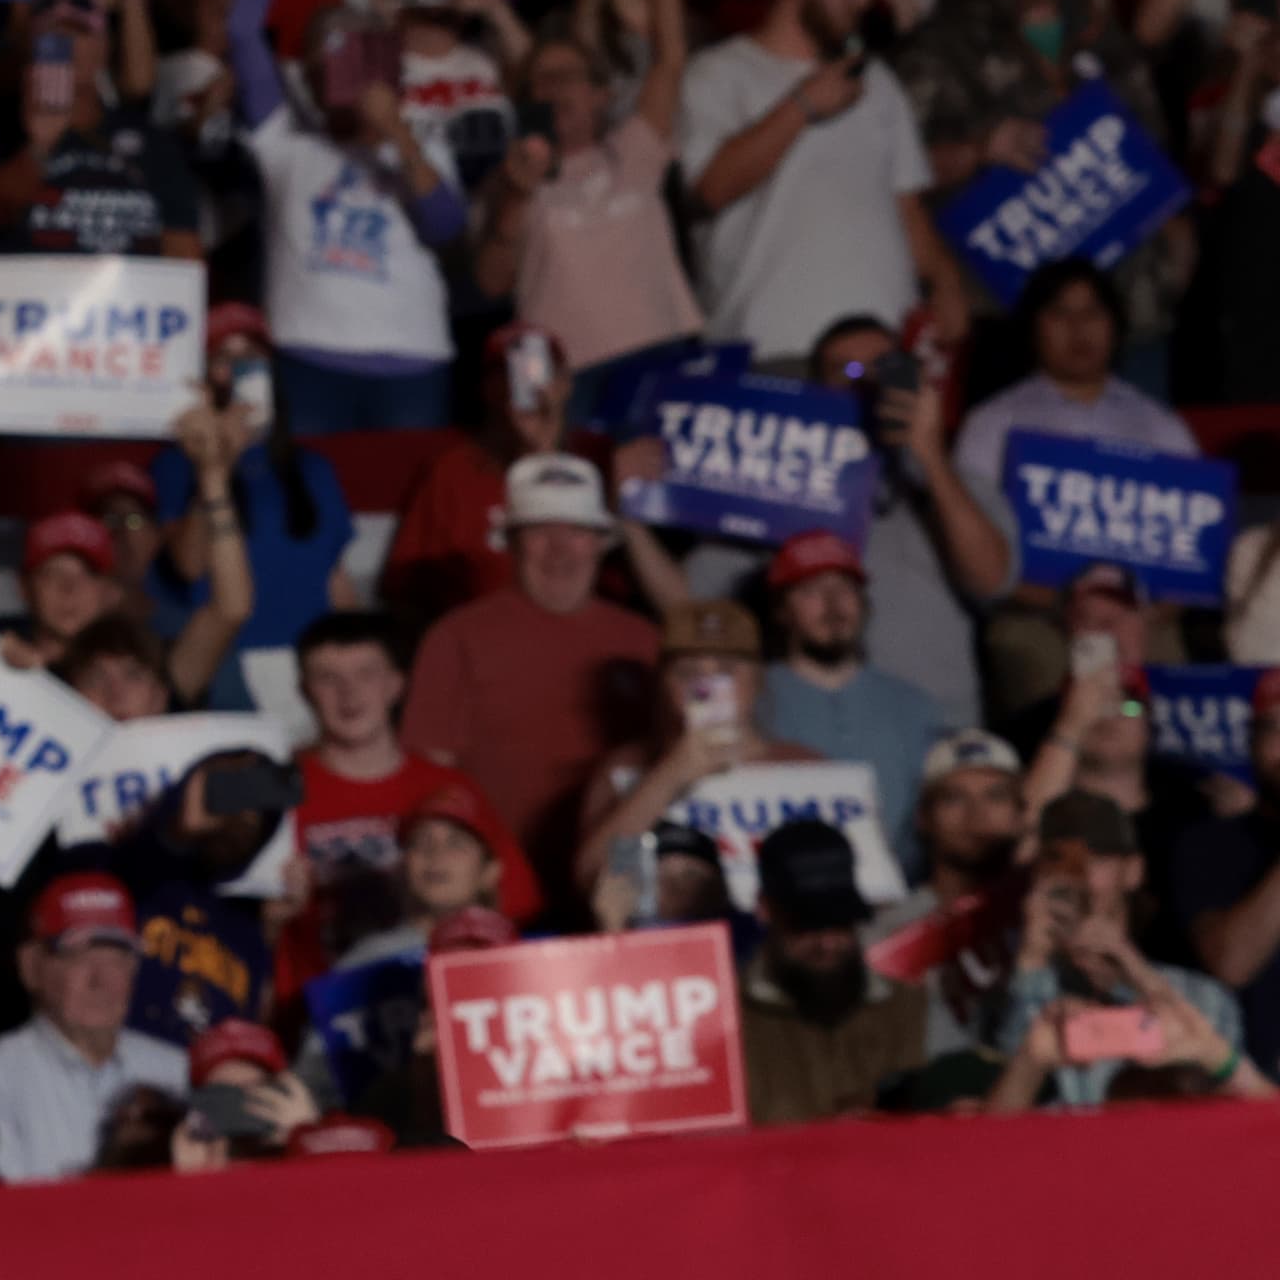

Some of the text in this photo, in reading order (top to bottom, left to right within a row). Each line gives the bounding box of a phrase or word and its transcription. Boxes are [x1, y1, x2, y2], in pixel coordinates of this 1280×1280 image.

[964, 114, 1130, 256] TRUMP
[659, 402, 871, 466] TRUMP
[670, 434, 839, 498] VANCE
[1017, 462, 1226, 528] TRUMP
[1040, 498, 1203, 562] VANCE
[687, 795, 866, 833] RUMP
[451, 975, 717, 1055] TRUMP
[490, 1022, 698, 1089] VANCE
